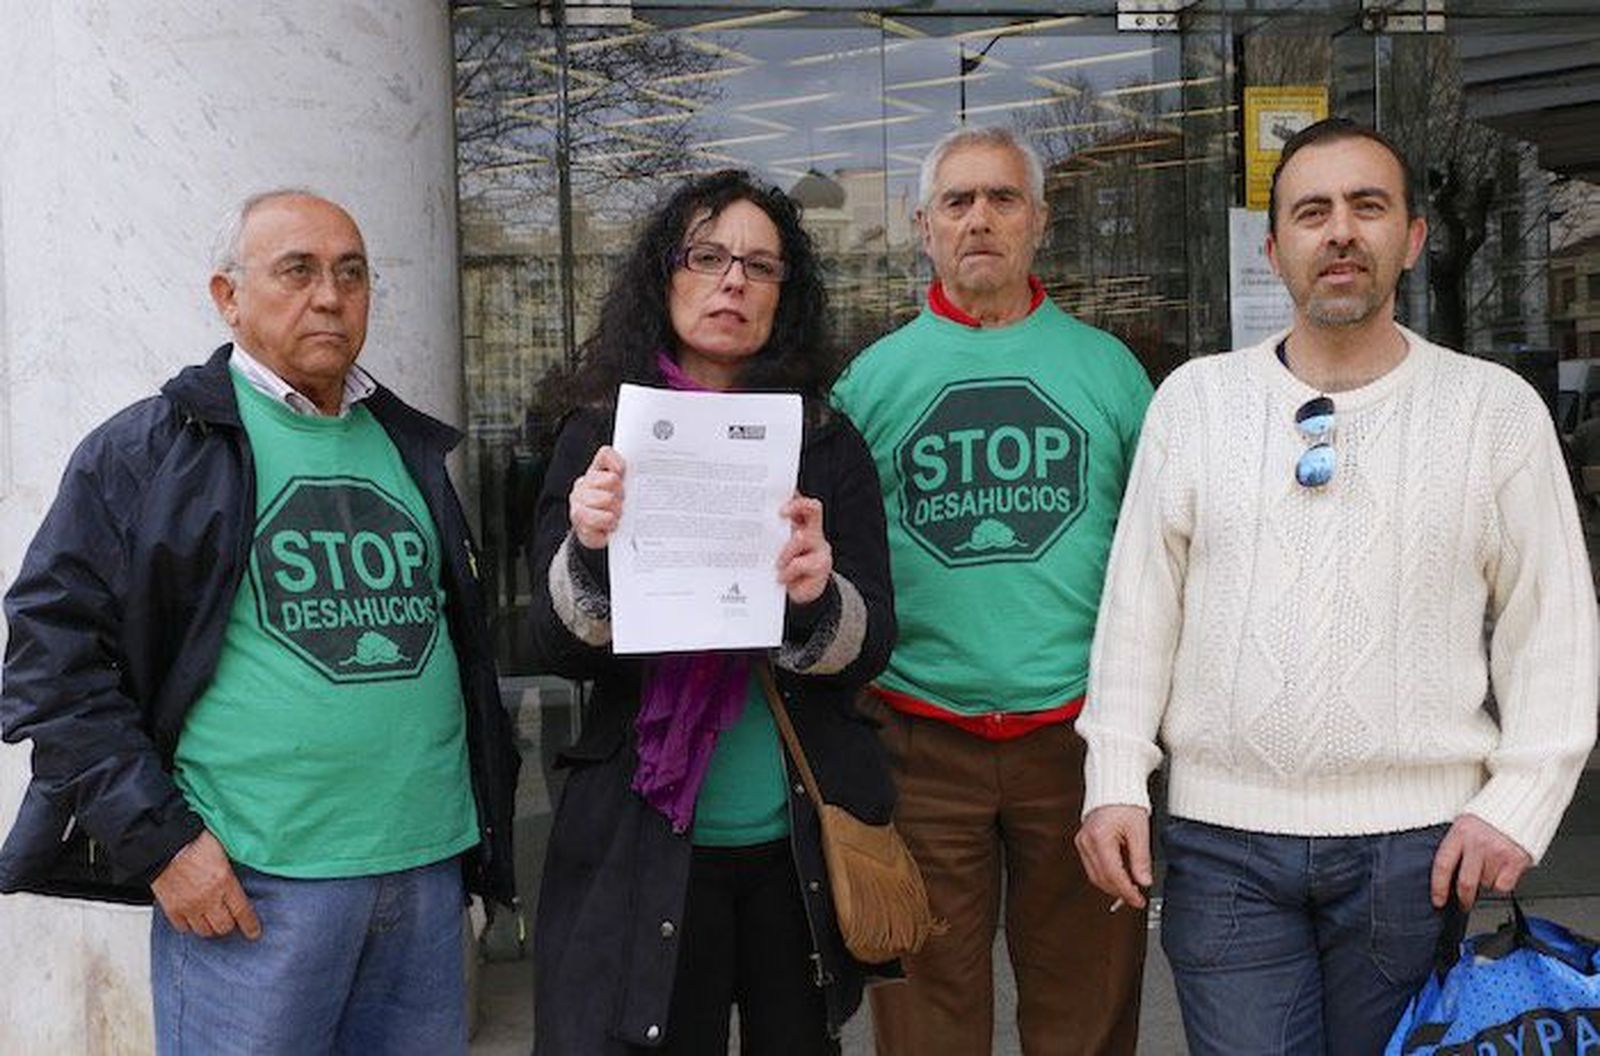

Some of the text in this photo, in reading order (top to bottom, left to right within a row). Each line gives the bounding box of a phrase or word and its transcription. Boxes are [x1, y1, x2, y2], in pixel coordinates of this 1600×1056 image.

[912, 425, 1070, 491] STOP
[914, 485, 1070, 525] DESAHUCIOS
[271, 529, 424, 592] STOP
[281, 596, 437, 632] DESAHUCIOS
